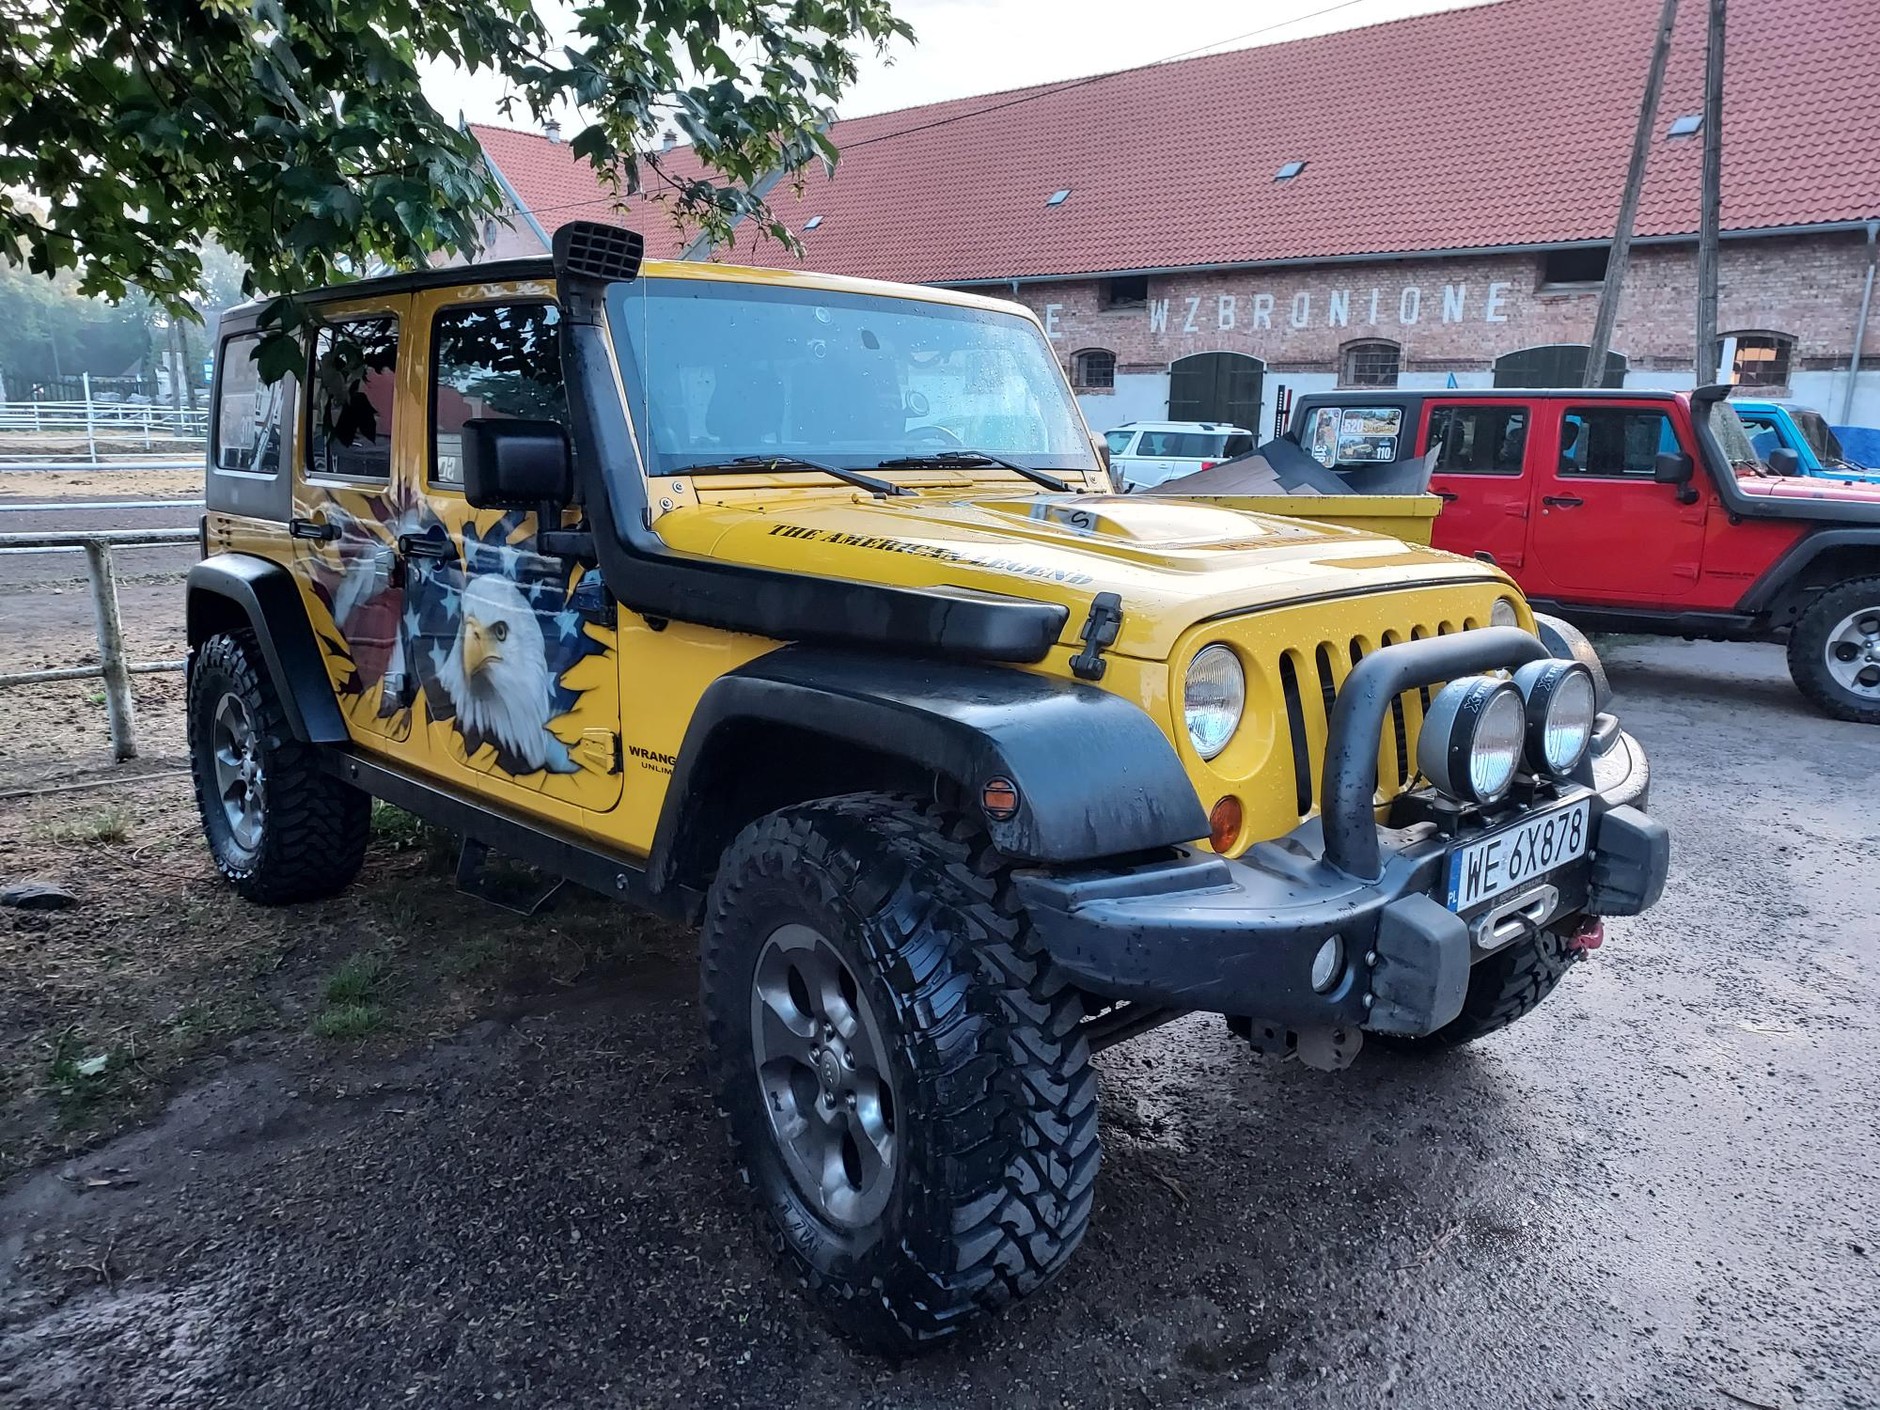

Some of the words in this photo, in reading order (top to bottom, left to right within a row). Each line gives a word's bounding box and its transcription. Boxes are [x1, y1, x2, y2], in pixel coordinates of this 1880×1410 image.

[1149, 281, 1512, 334] WZBRONIONE
[1376, 446, 1391, 460] 110
[768, 524, 823, 541] THE
[819, 532, 970, 562] AMERICAN
[970, 556, 1094, 587] LEGEND
[1465, 840, 1502, 901] WE
[1509, 808, 1583, 880] 6X878
[1447, 892, 1457, 906] PL
